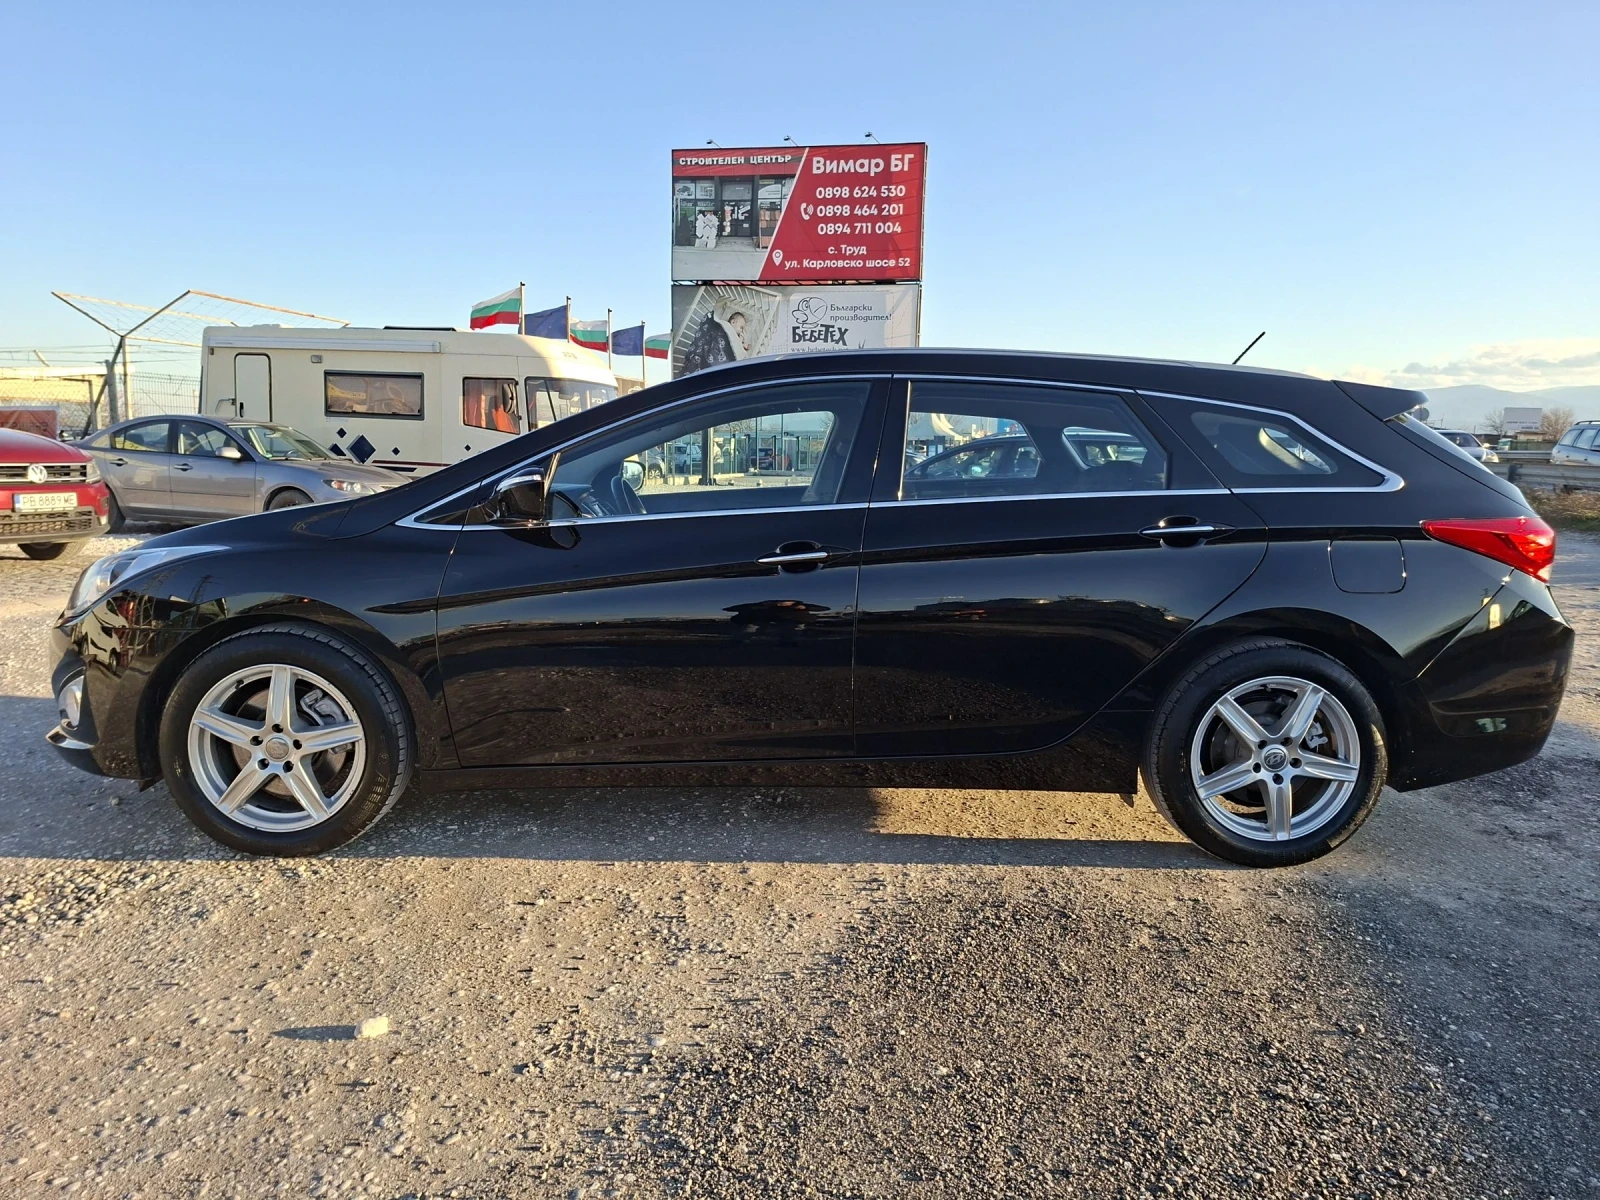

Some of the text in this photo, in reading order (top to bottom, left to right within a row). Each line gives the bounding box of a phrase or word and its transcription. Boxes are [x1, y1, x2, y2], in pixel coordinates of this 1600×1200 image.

[679, 155, 792, 165] СТРОИТЕЛЕН ЦЕНТЪР
[812, 154, 915, 177] Вимар БГ
[816, 185, 906, 199] 0898 624 530
[816, 203, 904, 217] 0898 464 201
[817, 222, 902, 235] 0894 711 004
[828, 244, 867, 256] с. Труд
[784, 258, 911, 270] ул. Карловско шосе 52
[830, 304, 873, 313] Български
